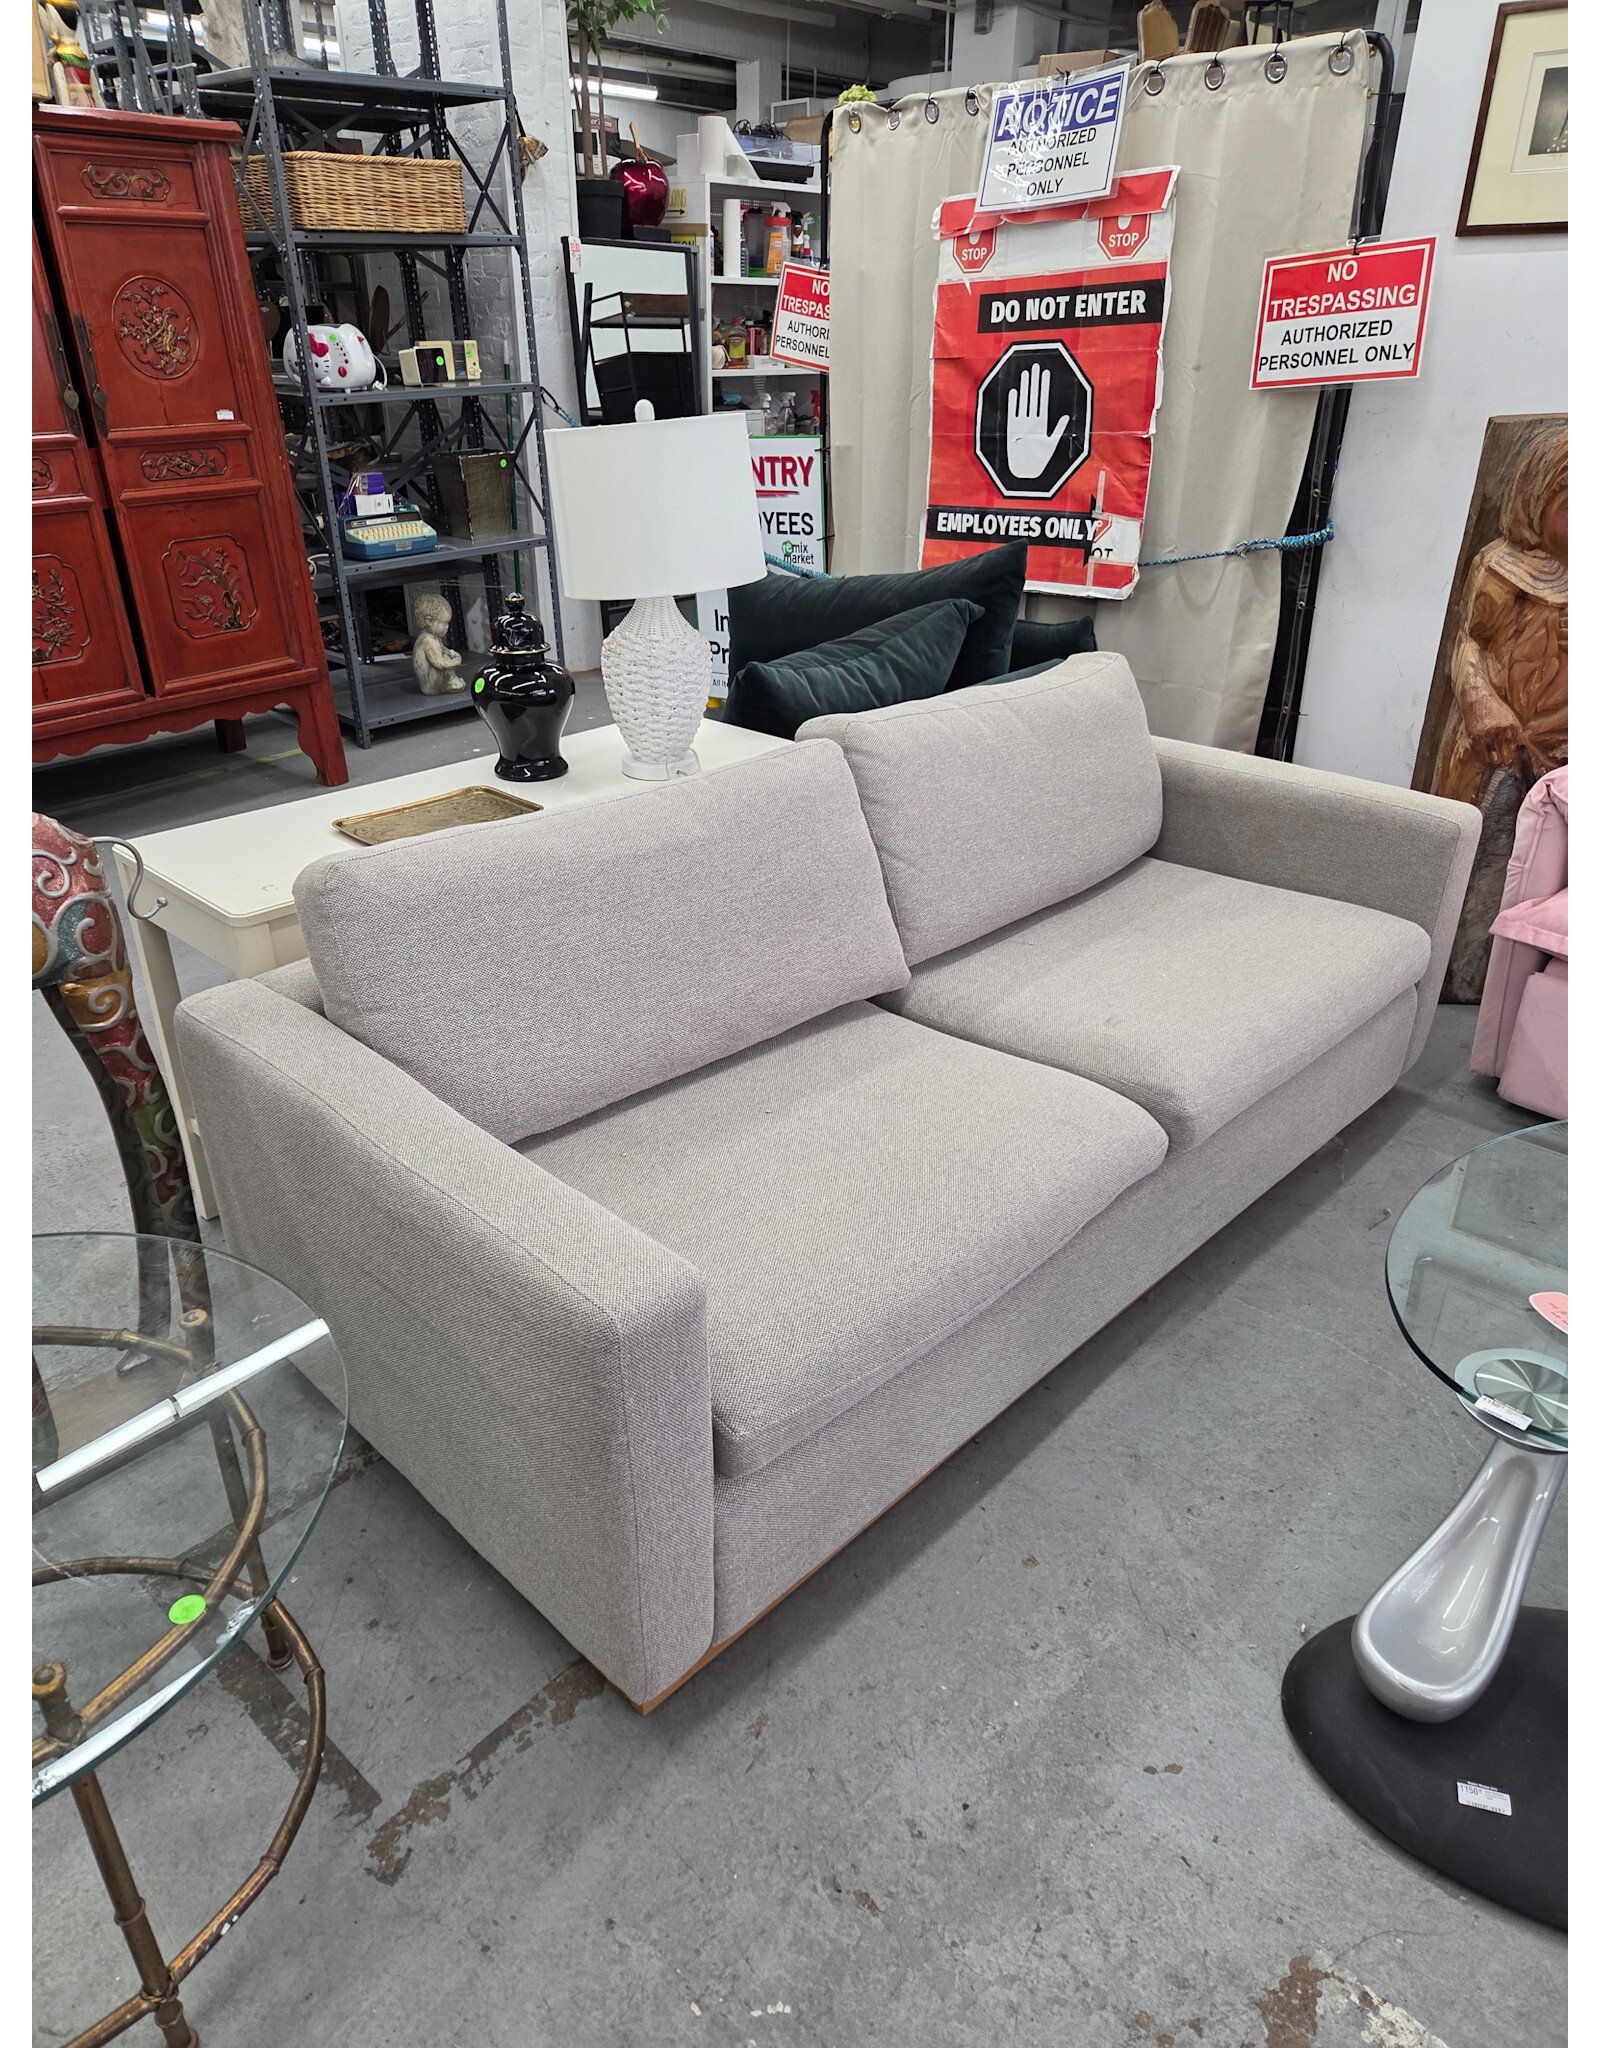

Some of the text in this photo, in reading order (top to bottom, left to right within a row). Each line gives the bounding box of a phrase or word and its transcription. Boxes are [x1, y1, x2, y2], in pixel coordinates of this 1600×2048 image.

[997, 81, 1121, 137] NOTICE
[1026, 178, 1064, 197] ONLY
[1108, 231, 1140, 248] STOP
[961, 247, 988, 262] STOP
[1326, 260, 1359, 284] NO
[811, 279, 830, 297] NO
[990, 289, 1147, 324] DO NOT ENTER
[1270, 284, 1416, 321] TRESPASSING
[1280, 319, 1393, 346] AUTHORIZED
[775, 335, 830, 359] PERSONNEL
[1258, 342, 1416, 372] PERSONNEL ONLY
[759, 511, 814, 536] YEES
[936, 512, 1042, 538] EMPLOYEES
[1044, 517, 1098, 541] ONLY
[782, 541, 809, 555] remix
[783, 553, 815, 566] market
